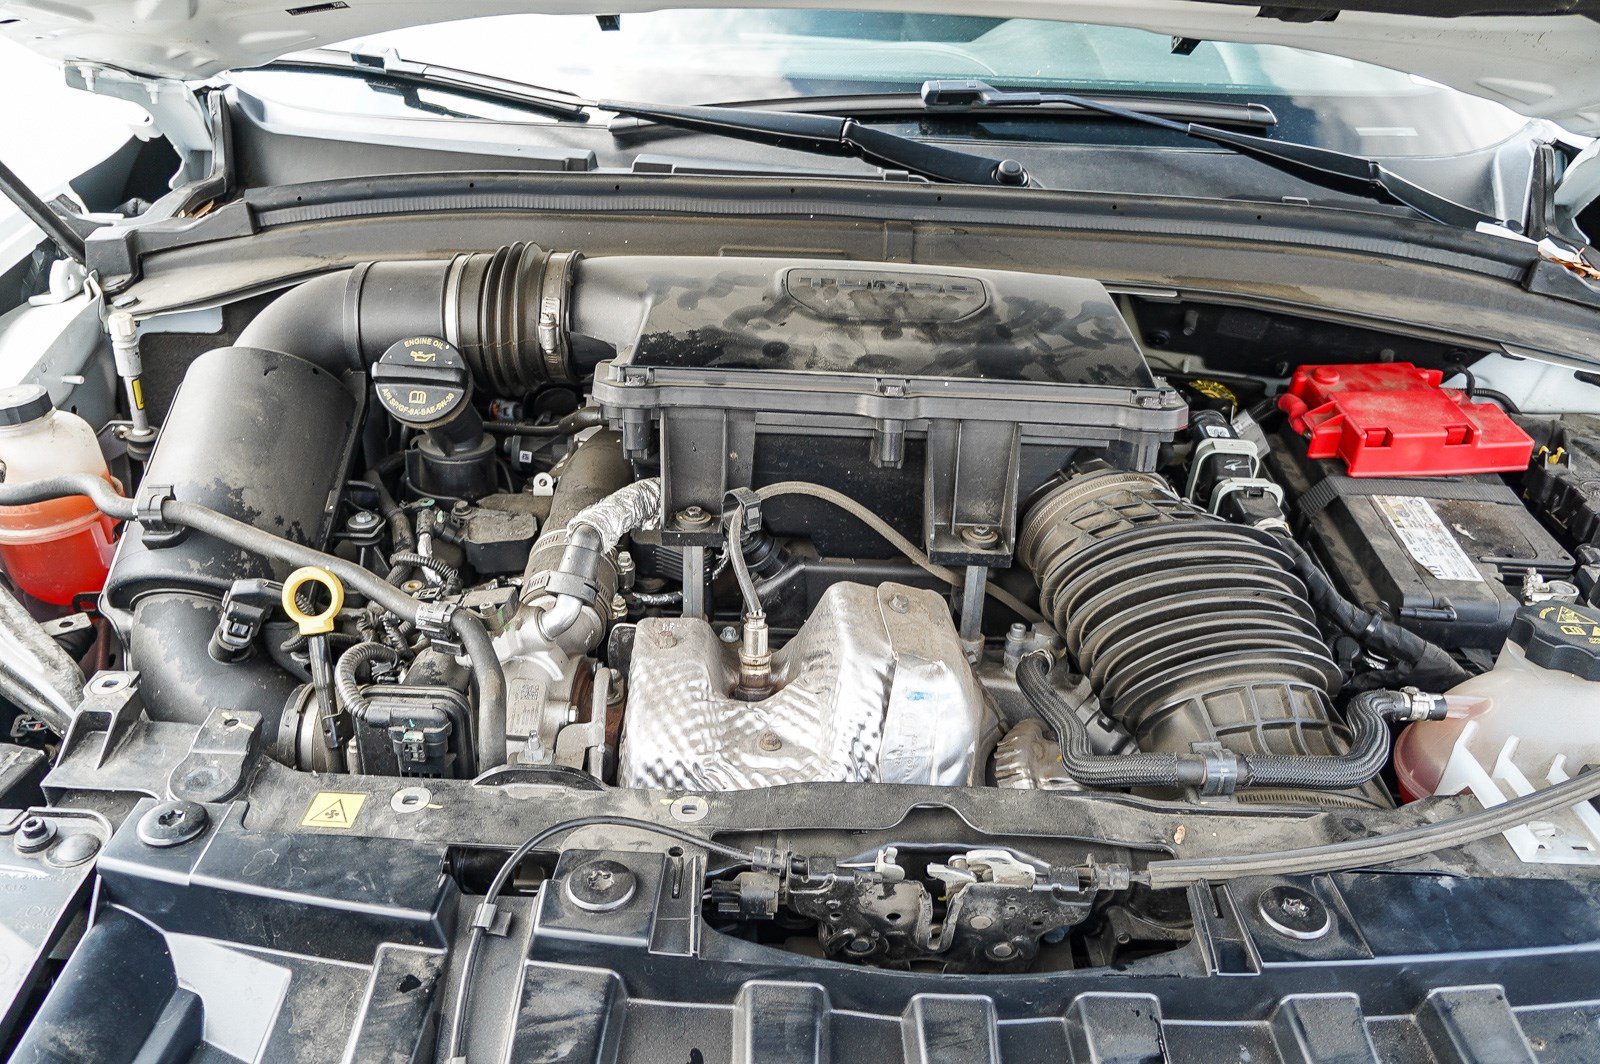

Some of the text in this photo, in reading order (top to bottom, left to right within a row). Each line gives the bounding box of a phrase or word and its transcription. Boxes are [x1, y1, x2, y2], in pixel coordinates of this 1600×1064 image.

[404, 337, 445, 350] ENGINE OIL
[382, 388, 392, 401] API
